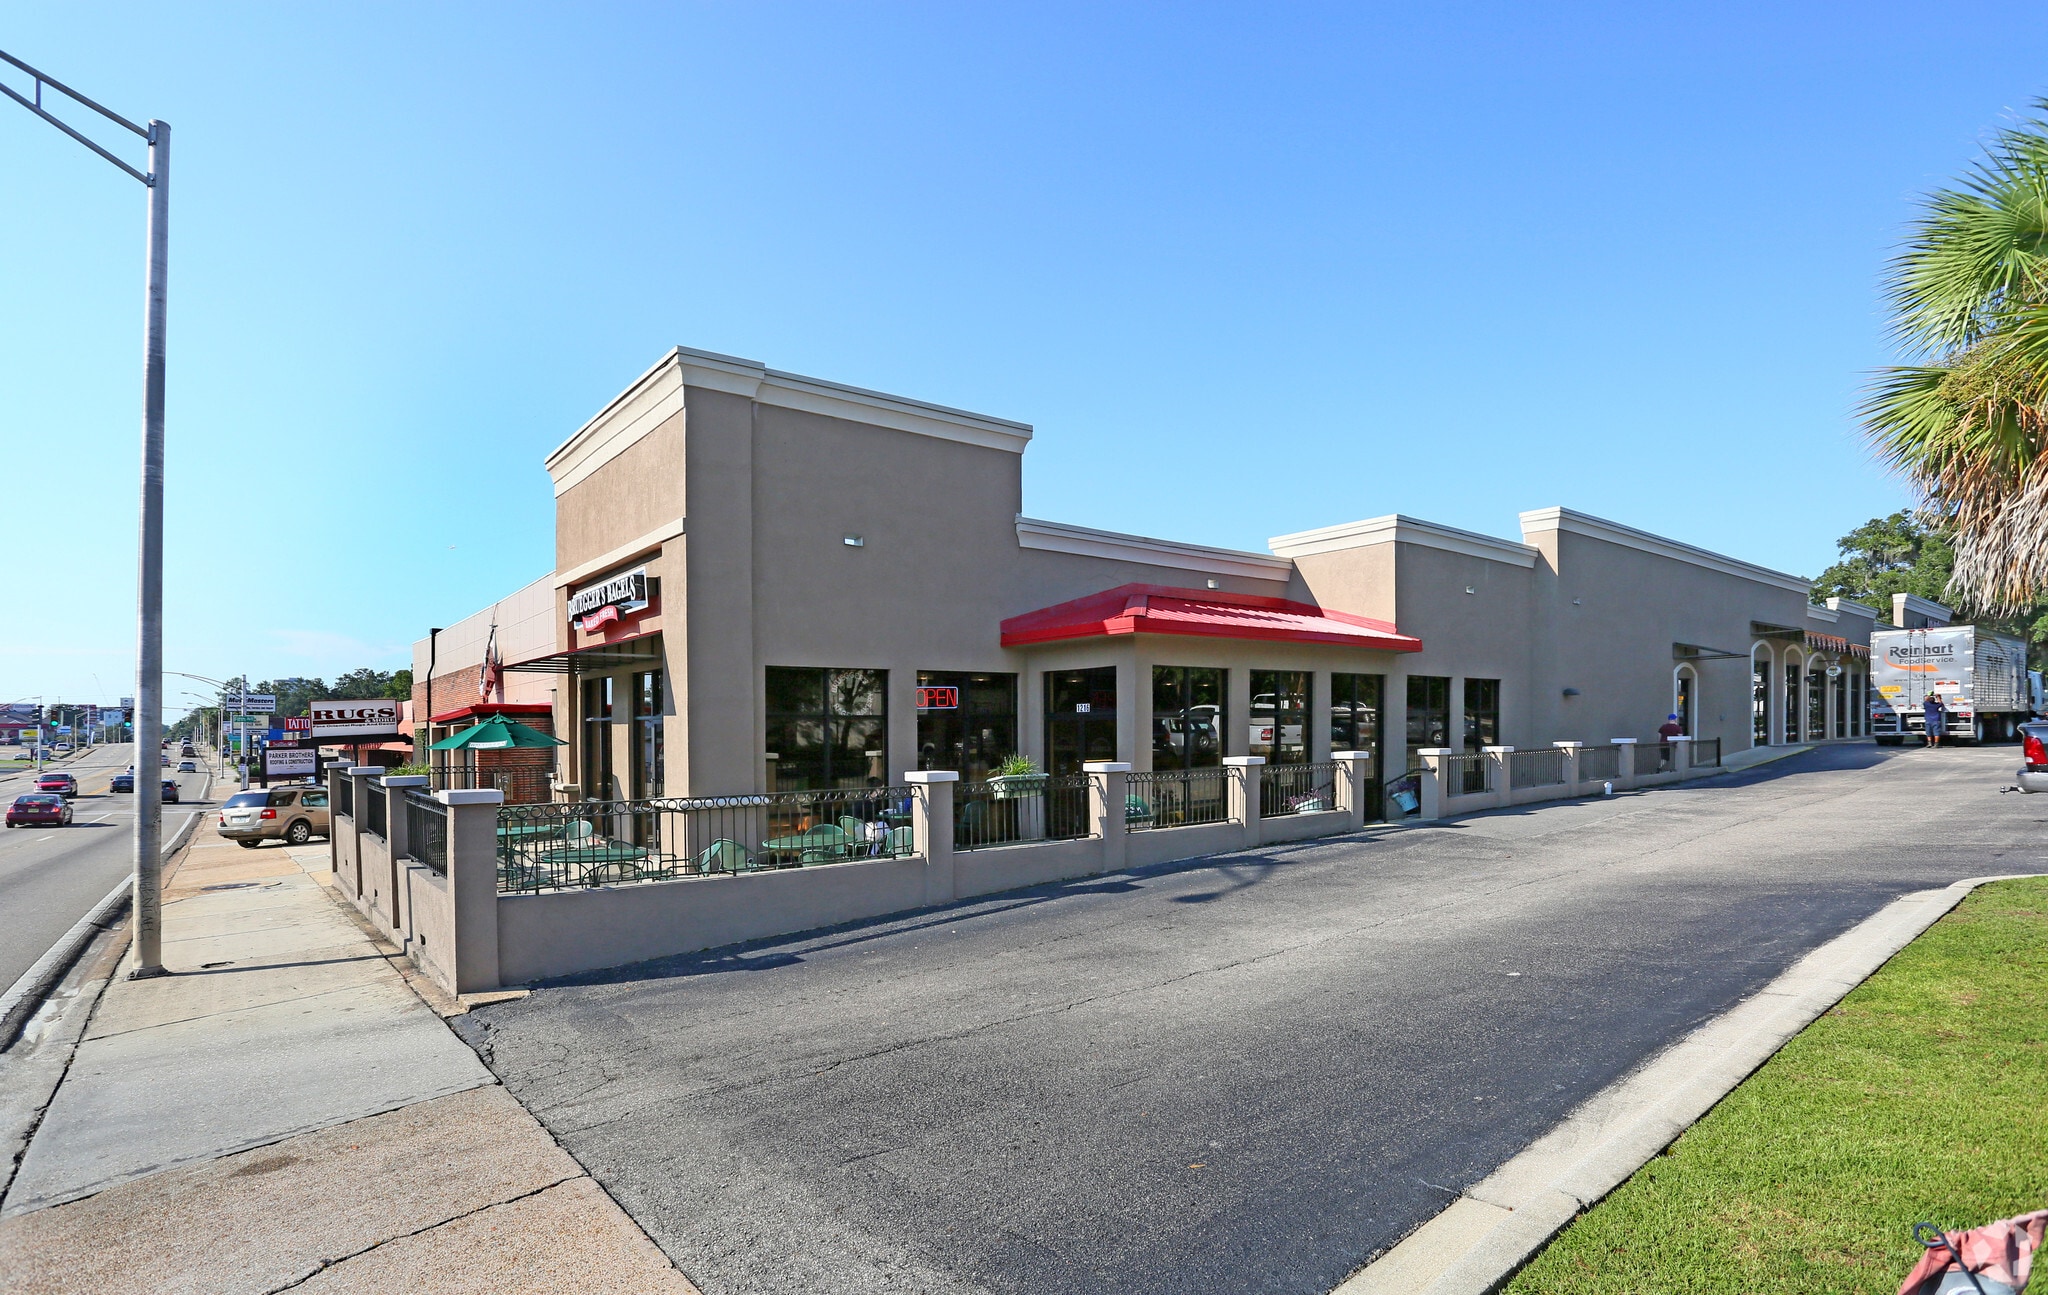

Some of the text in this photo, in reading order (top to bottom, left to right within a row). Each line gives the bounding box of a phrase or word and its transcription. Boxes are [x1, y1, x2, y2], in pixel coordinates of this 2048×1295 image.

[567, 575, 636, 622] BRUEGGER'S BAGELS
[599, 607, 614, 620] FRESH
[1890, 643, 1954, 658] Reinhart
[916, 688, 957, 707] OPEN
[313, 707, 395, 719] RUGS
